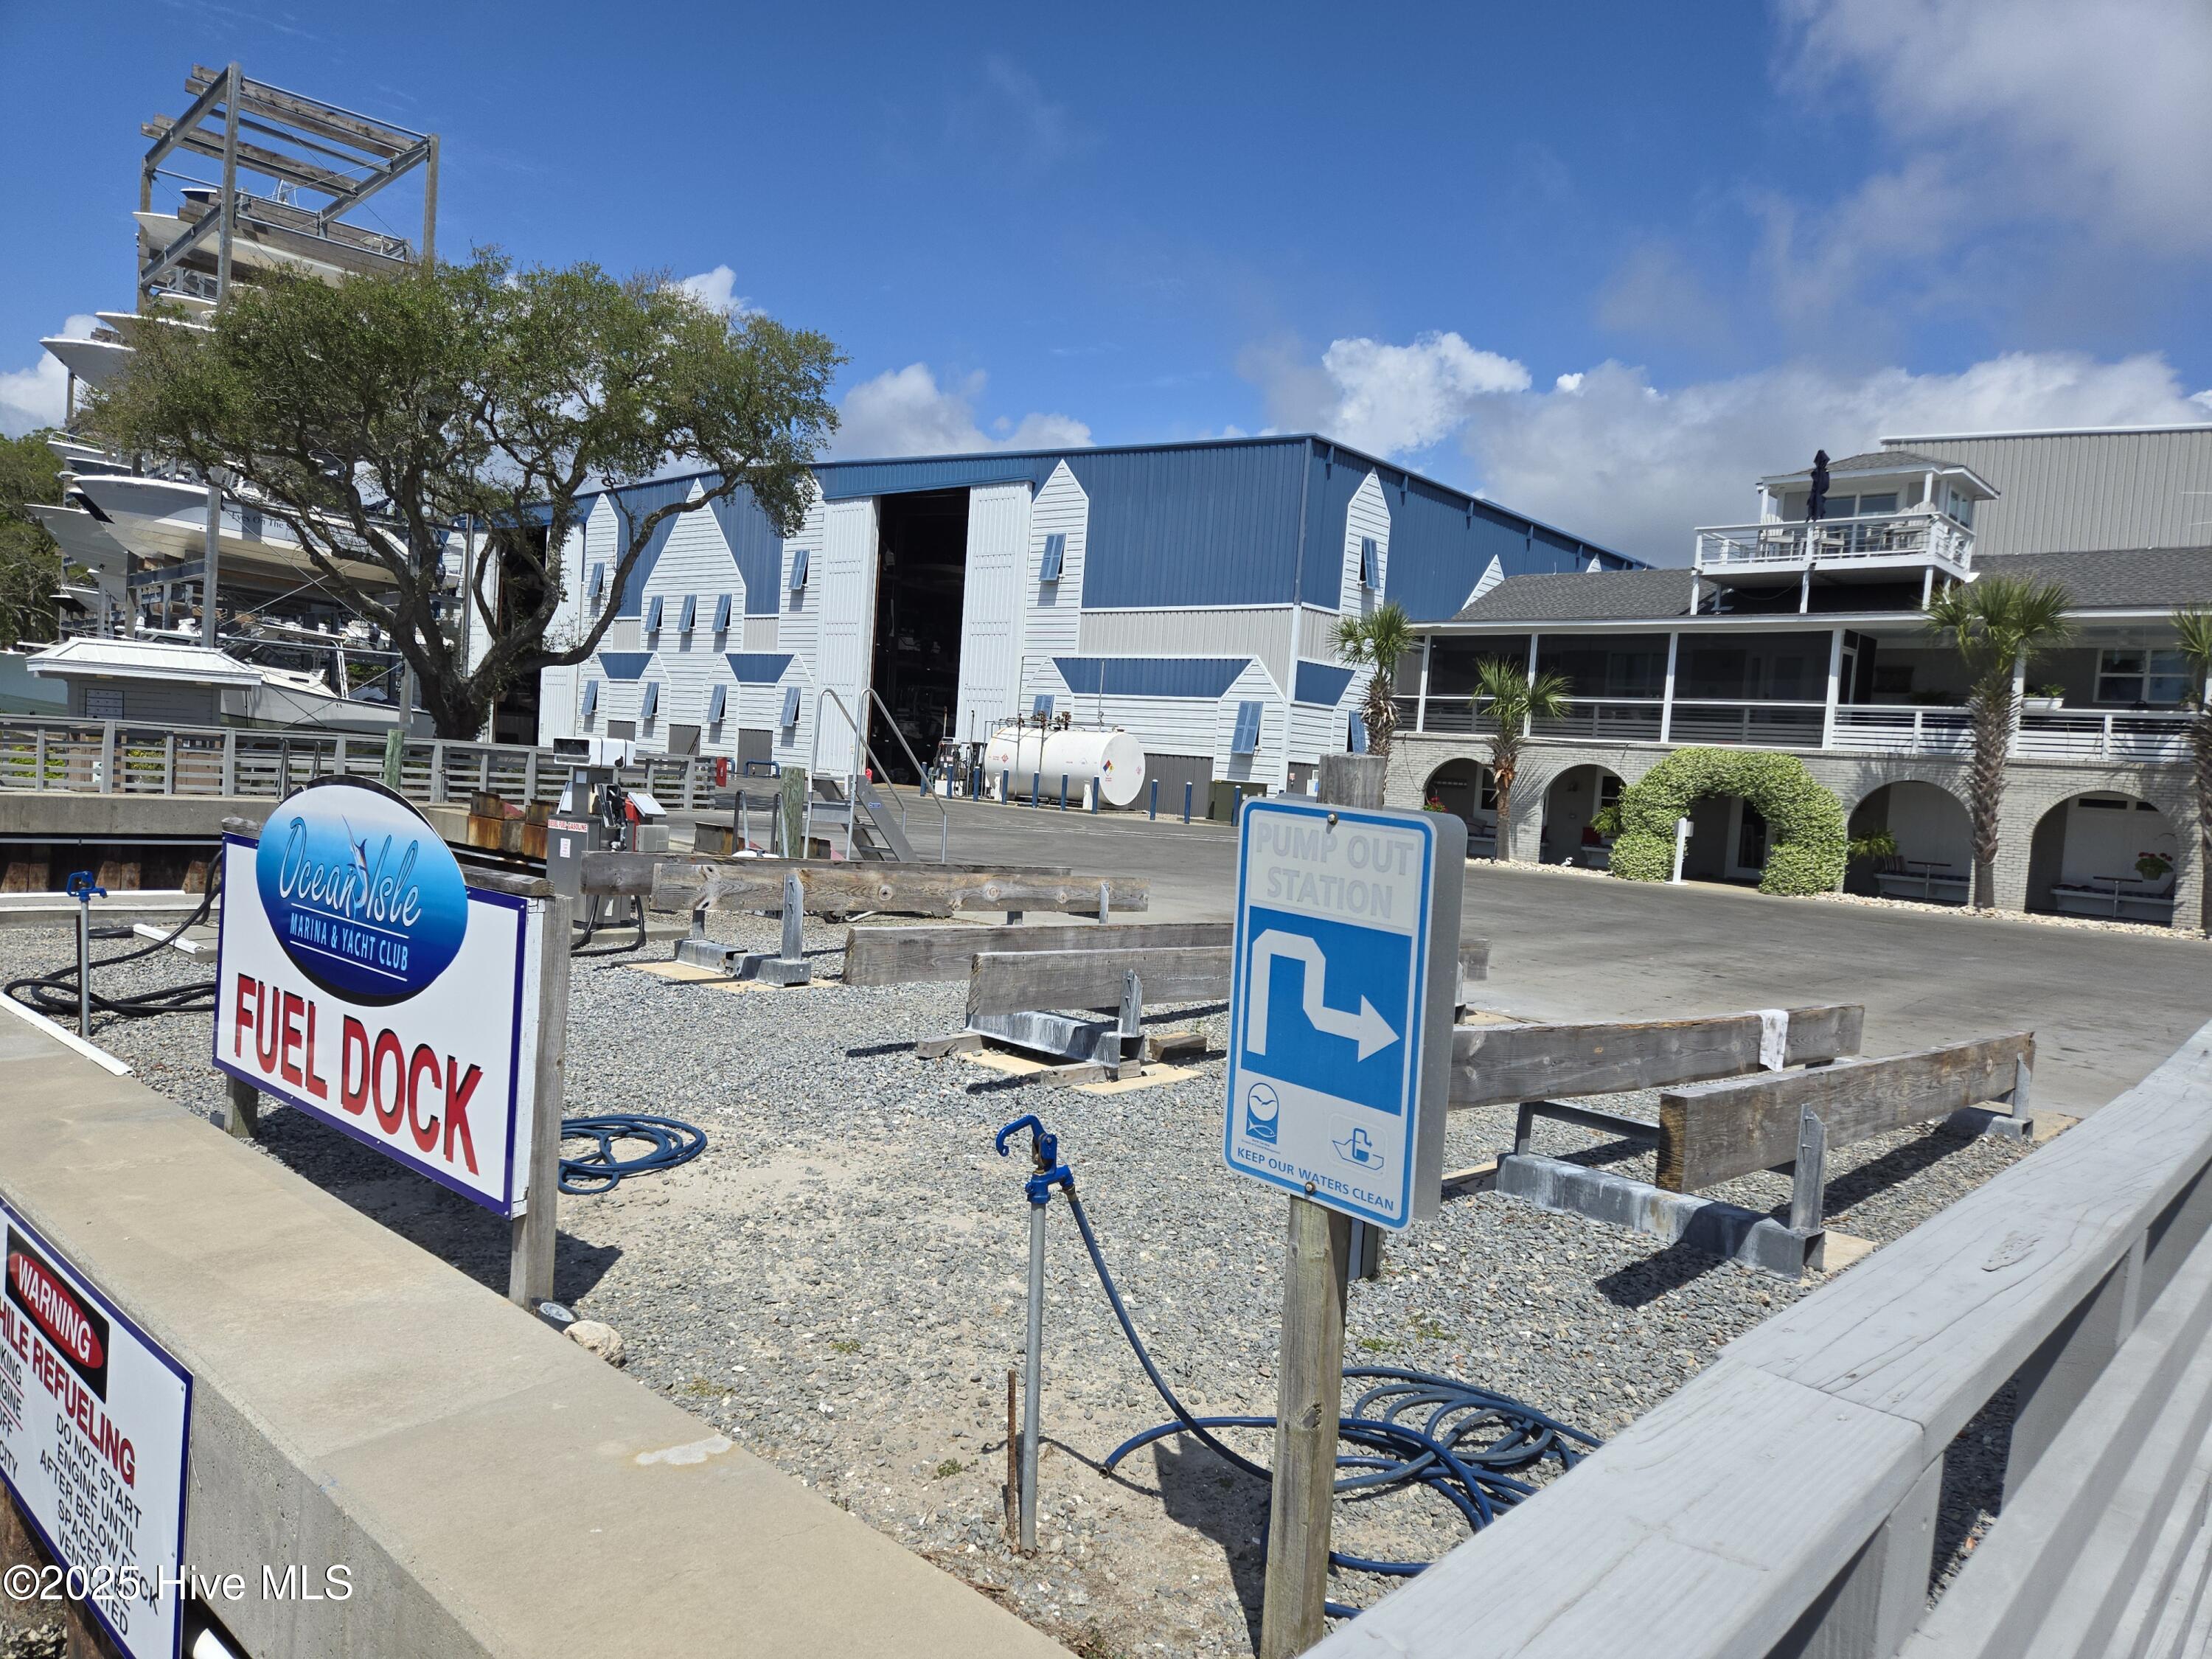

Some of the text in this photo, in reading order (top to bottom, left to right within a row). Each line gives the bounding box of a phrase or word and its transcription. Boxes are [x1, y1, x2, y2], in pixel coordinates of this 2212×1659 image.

[254, 517, 265, 525] On
[269, 519, 283, 529] The
[568, 822, 588, 832] GASOLINE
[1256, 822, 1414, 876] PUMP OUT
[279, 816, 422, 927] Ocean Isle
[1267, 866, 1393, 919] STATION
[290, 912, 408, 971] MARINA & YACHT CLUB
[234, 973, 484, 1176] FUEL DOCK
[1237, 1147, 1265, 1164] KEEP
[1268, 1158, 1294, 1175] OUR
[1298, 1167, 1349, 1194] WATERS
[1352, 1188, 1394, 1211] CLEAN
[18, 1254, 91, 1363] WARNING
[0, 1343, 21, 1387] KING
[0, 1374, 21, 1421] GINE
[32, 1335, 136, 1491] REFUELING
[40, 1448, 72, 1505] AFTER
[76, 1493, 118, 1562] BELOW
[57, 1413, 142, 1529] DO NOT START
[58, 1441, 136, 1558] ENGINE UNTIL
[58, 1499, 102, 1572] SPACES
